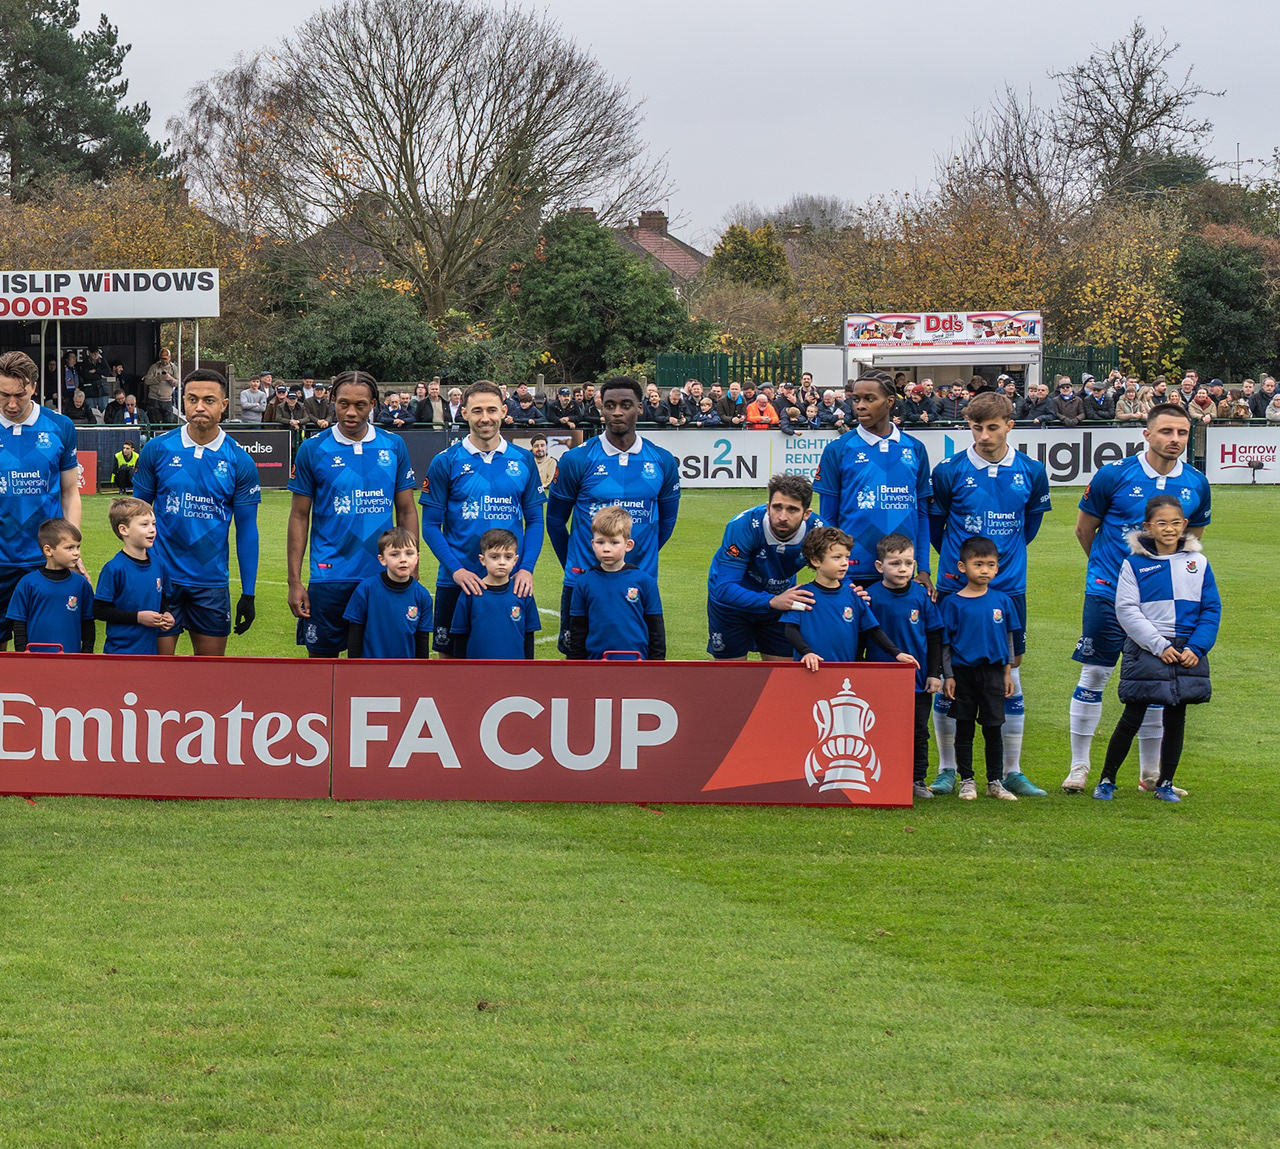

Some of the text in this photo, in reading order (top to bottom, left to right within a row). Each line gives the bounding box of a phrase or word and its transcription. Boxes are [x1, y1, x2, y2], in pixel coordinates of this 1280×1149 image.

[924, 314, 965, 333] Dd's
[785, 439, 831, 450] LIGHTI
[1220, 444, 1277, 463] Harrow
[11, 470, 41, 479] Brunel
[11, 478, 48, 489] University
[12, 486, 42, 495] London
[355, 488, 384, 498] Brunel
[880, 485, 909, 494] Brunel
[185, 493, 214, 505] Brunel
[355, 497, 393, 507] University
[484, 495, 512, 504] Brunel
[880, 493, 915, 503] University
[184, 502, 223, 516] University
[355, 505, 385, 514] London
[483, 504, 519, 515] University
[880, 502, 909, 510] London
[183, 510, 214, 520] London
[483, 512, 512, 520] London
[987, 511, 1016, 520] Brunel
[987, 519, 1020, 529] University
[986, 527, 1014, 536] London
[349, 696, 461, 769] FA
[479, 696, 679, 771] CUP
